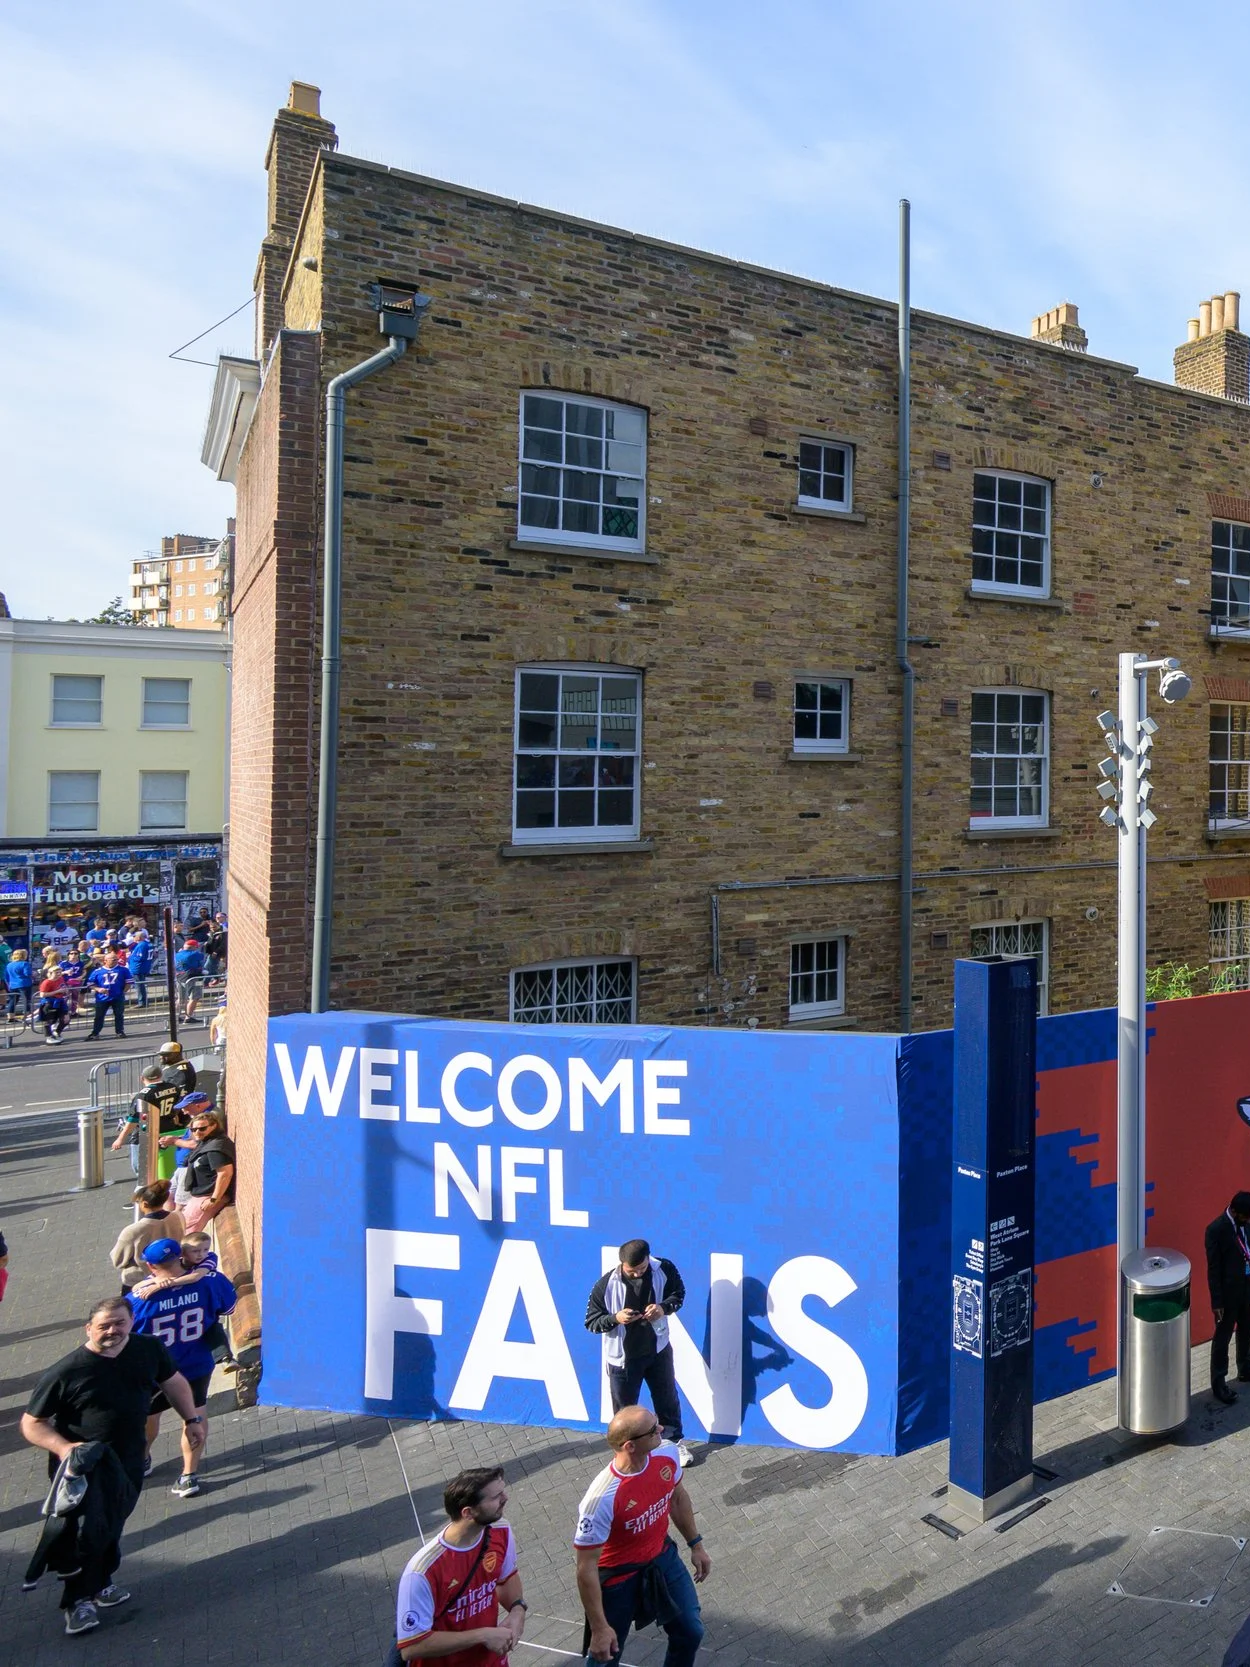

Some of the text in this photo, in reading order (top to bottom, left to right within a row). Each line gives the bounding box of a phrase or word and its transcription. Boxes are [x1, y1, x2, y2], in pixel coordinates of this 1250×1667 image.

[53, 868, 143, 886] Mother
[34, 883, 160, 903] Hubbard's
[103, 972, 119, 985] 17
[273, 1042, 691, 1136] WELCOME
[160, 1097, 175, 1117] 16
[996, 1164, 1028, 1178] Paxton Place
[434, 1142, 589, 1227] NFL
[990, 1239, 1001, 1247] Park
[1013, 1229, 1030, 1239] Square
[159, 1292, 199, 1312] MILANO
[152, 1307, 204, 1347] 58
[364, 1228, 869, 1449] FANS
[625, 1487, 675, 1531] Emirat
